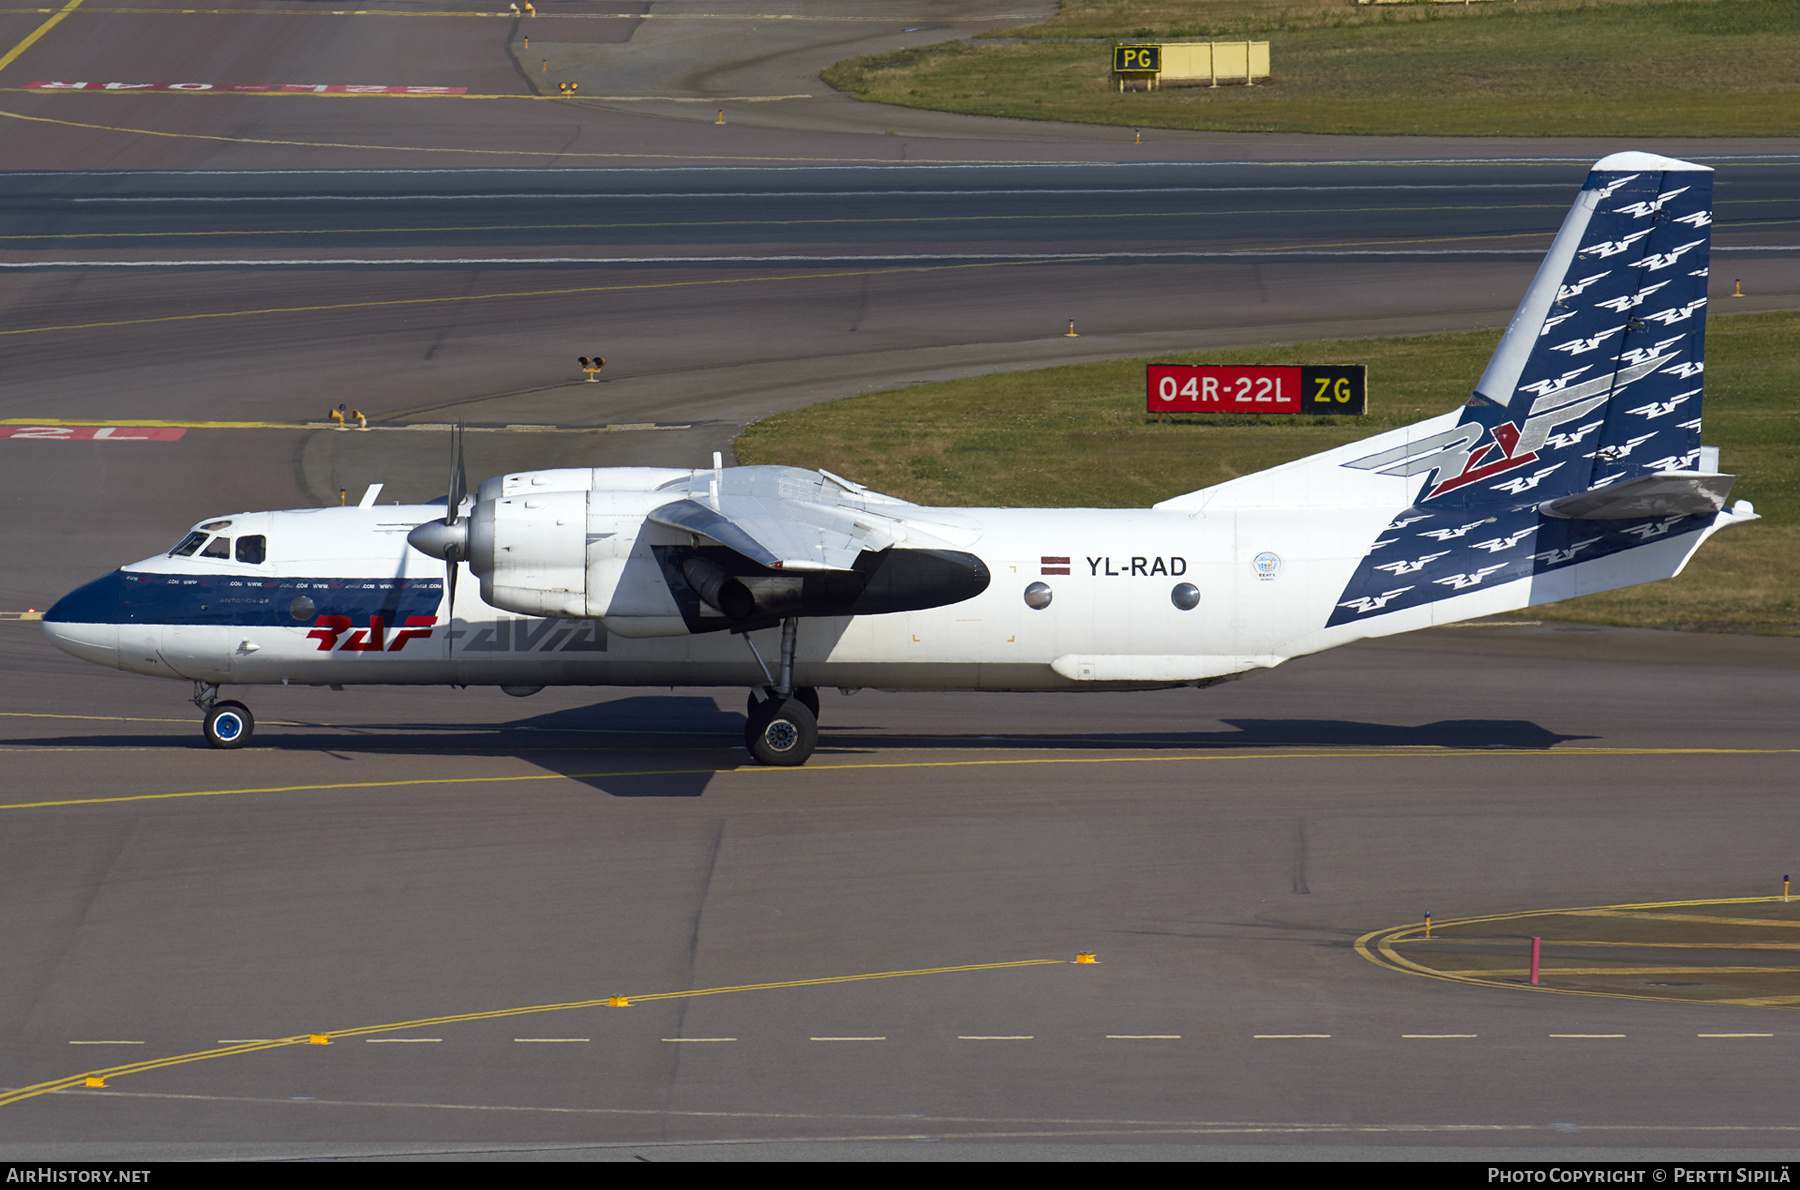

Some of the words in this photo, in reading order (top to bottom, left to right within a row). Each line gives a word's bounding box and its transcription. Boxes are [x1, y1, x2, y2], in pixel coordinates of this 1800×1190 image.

[1124, 49, 1151, 68] PG
[1159, 376, 1291, 402] 04R-22L
[1314, 377, 1350, 403] ZG
[1086, 556, 1187, 577] YL-RAD
